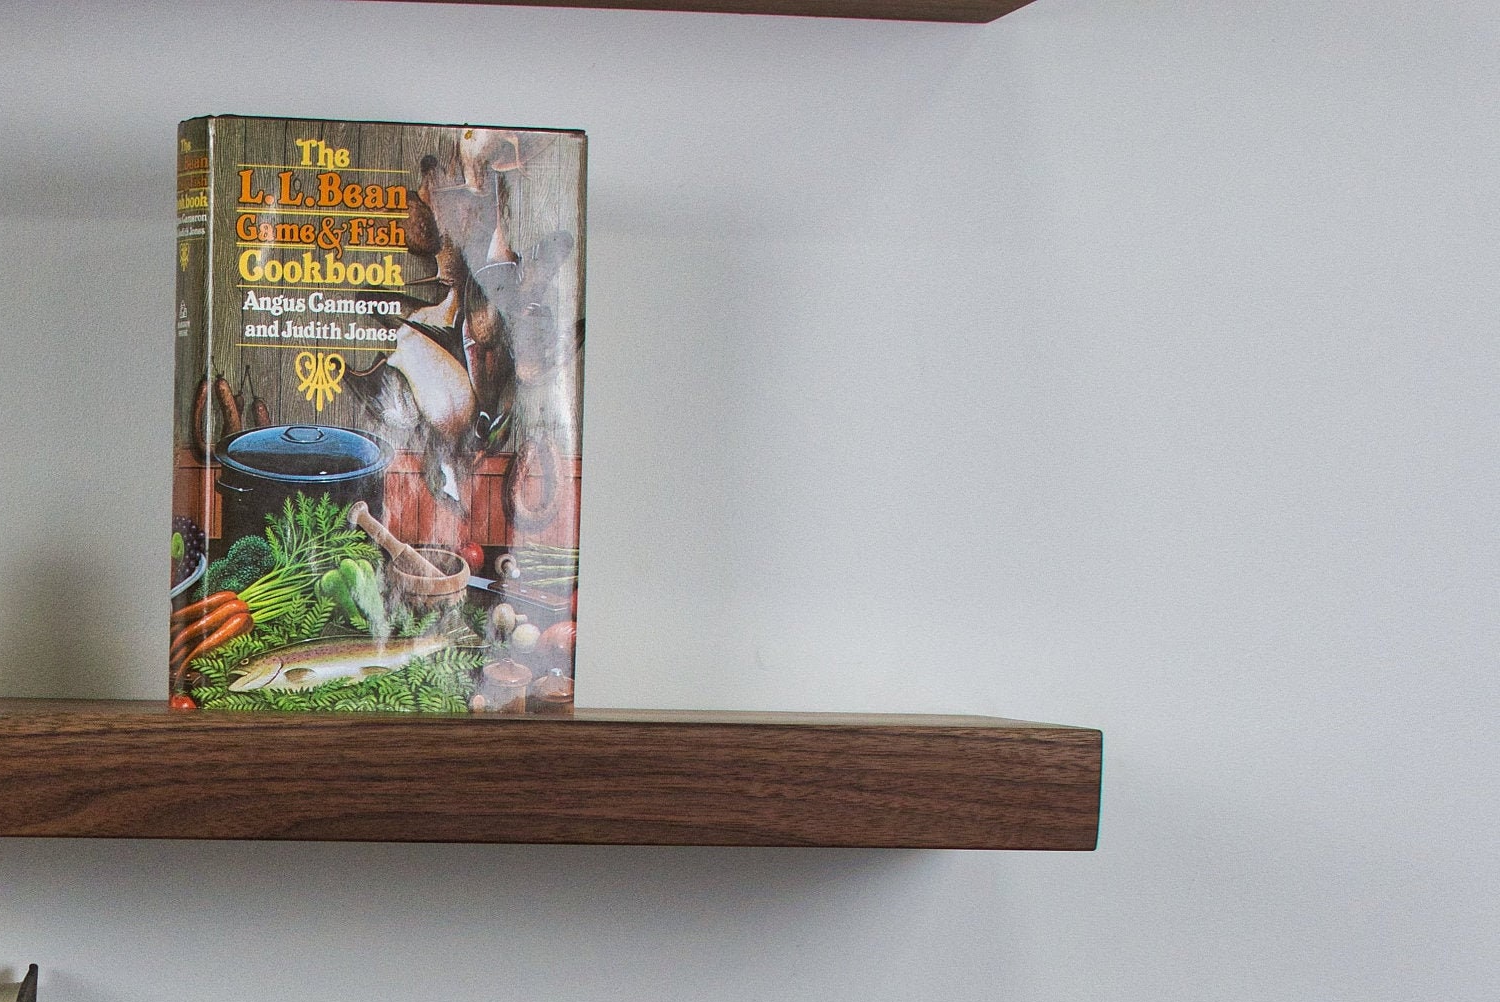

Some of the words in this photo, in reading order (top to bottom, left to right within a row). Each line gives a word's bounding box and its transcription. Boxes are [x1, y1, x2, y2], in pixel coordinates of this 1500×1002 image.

[295, 138, 350, 170] The
[235, 214, 315, 245] Game
[348, 217, 407, 247] Fish
[238, 249, 405, 287] Cookbook
[242, 292, 306, 317] Angus
[308, 292, 401, 315] Cameron
[245, 321, 280, 339] and
[281, 321, 342, 341] Judith
[344, 322, 398, 342] Jones
